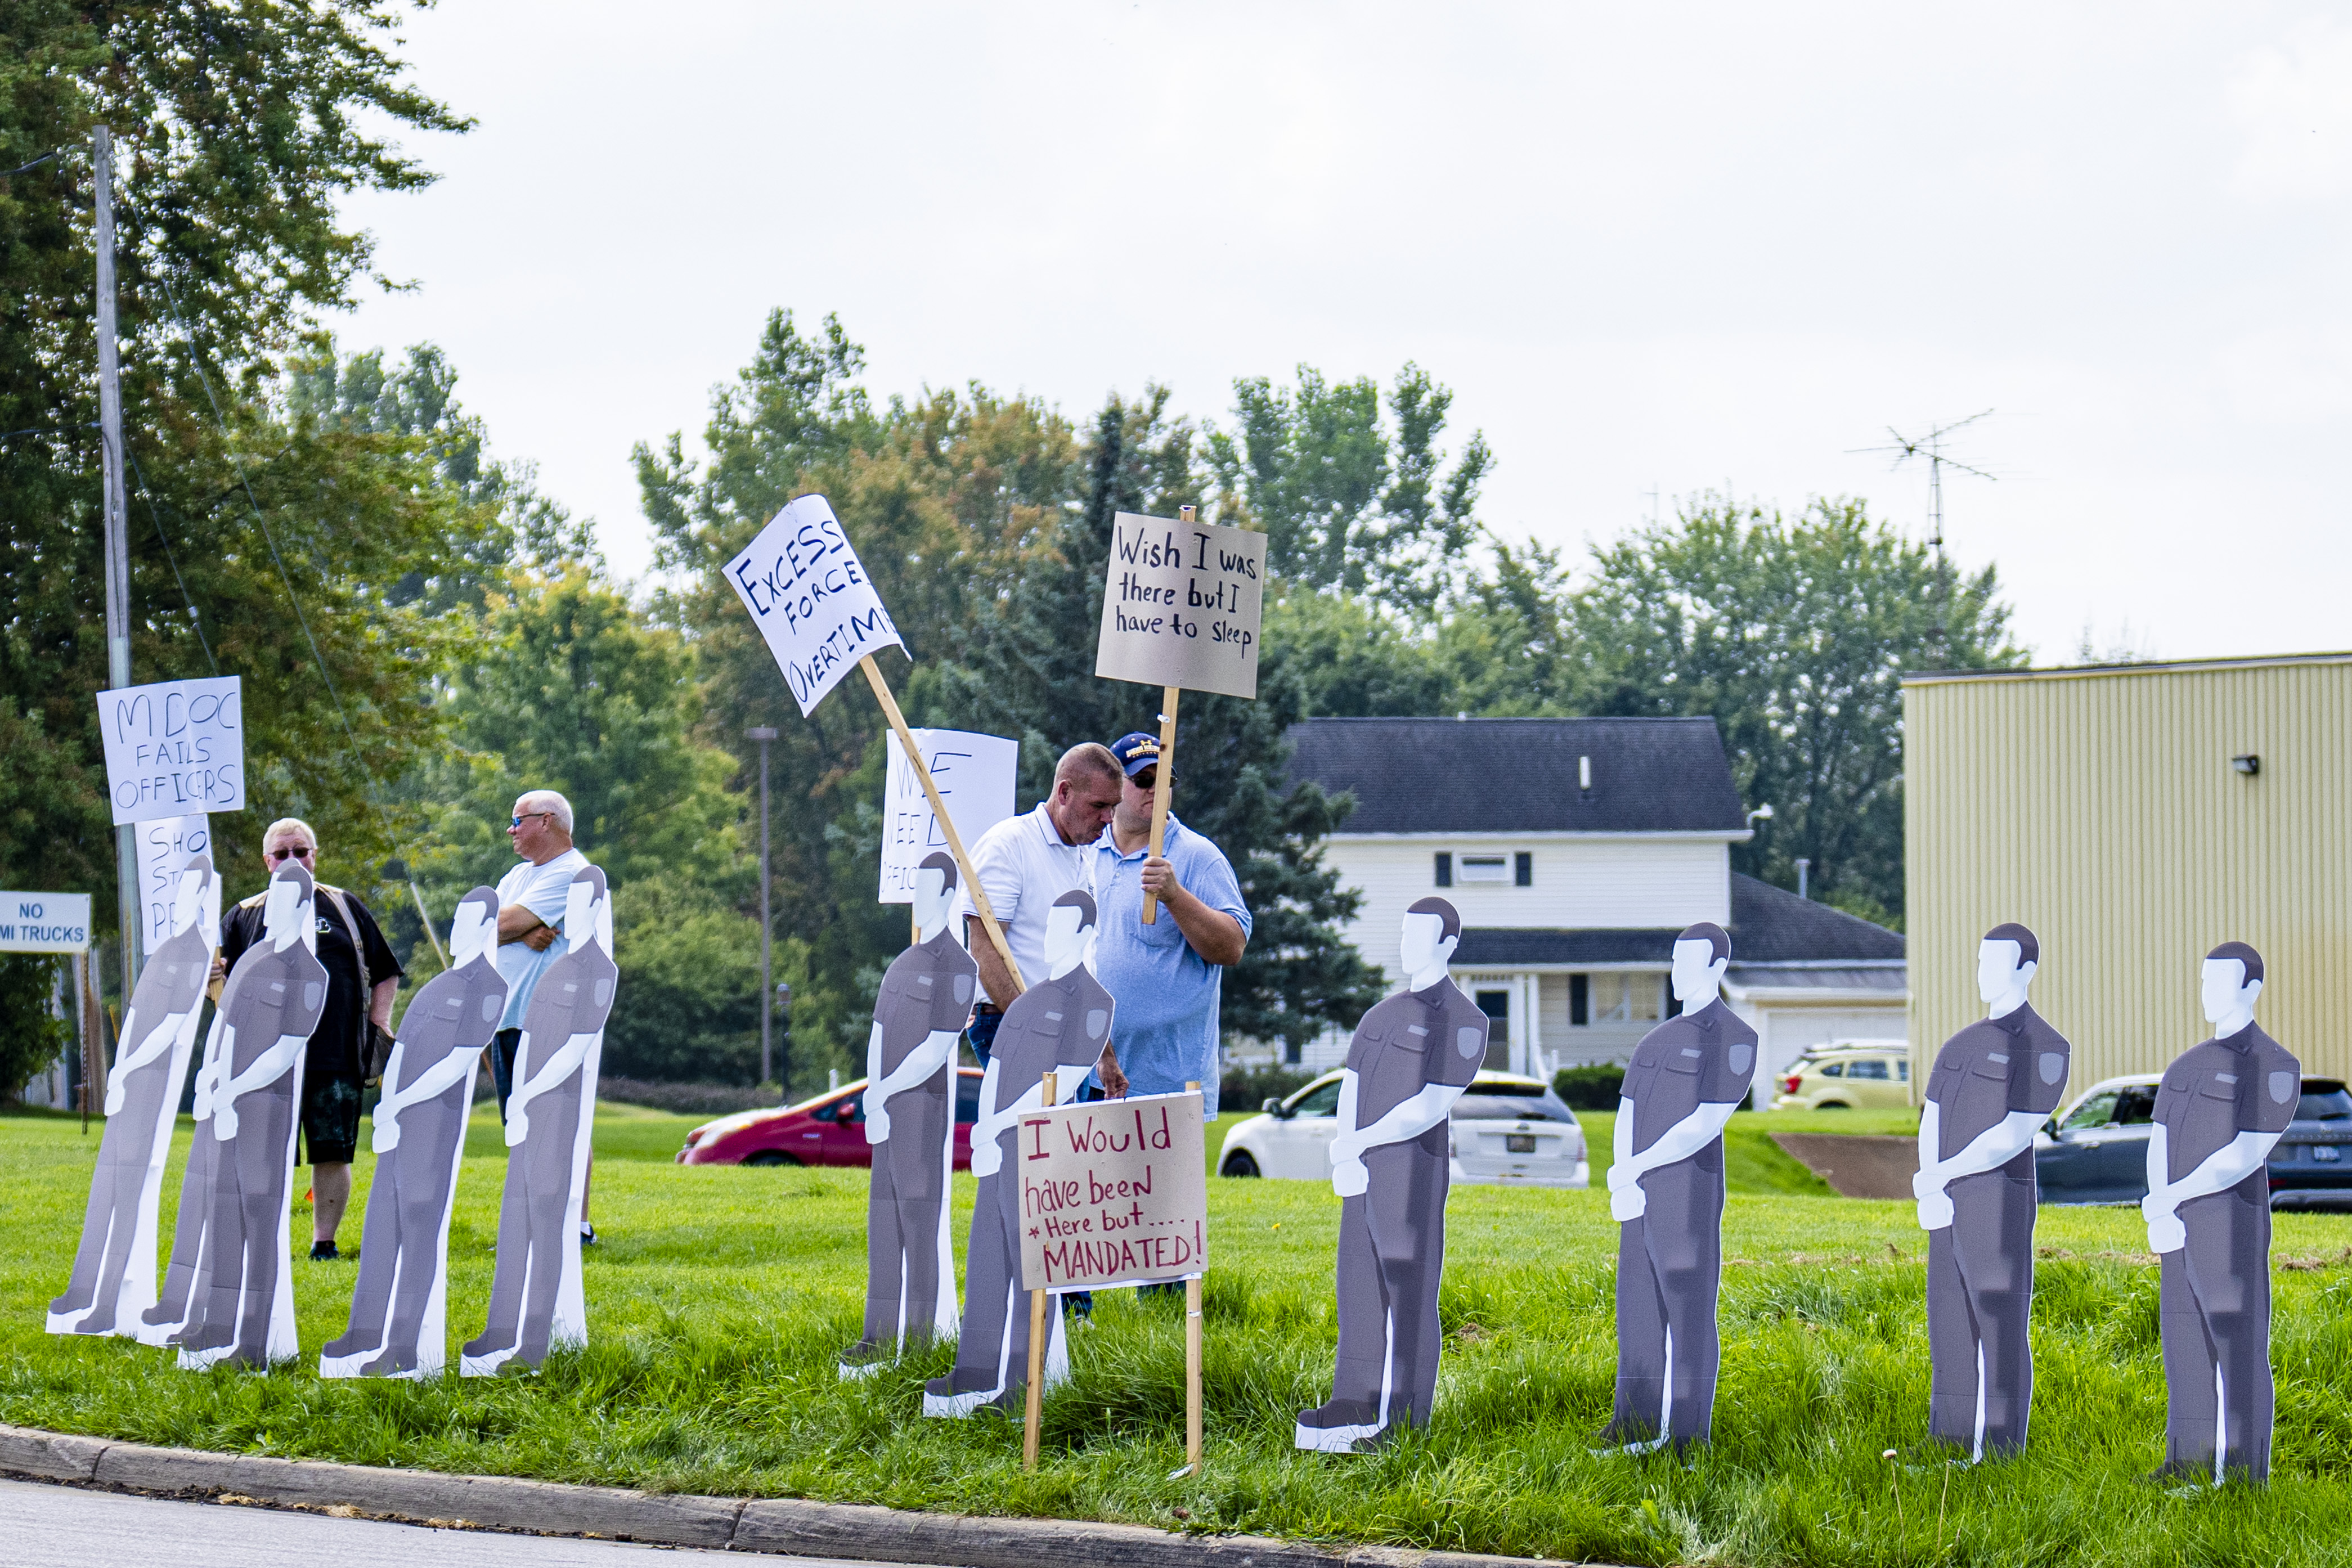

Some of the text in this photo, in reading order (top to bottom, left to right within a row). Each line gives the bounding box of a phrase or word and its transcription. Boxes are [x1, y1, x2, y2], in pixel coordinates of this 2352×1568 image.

[736, 520, 845, 617] EXCESS
[1119, 525, 1256, 579] Wish I was
[784, 560, 862, 636] FORCE
[1119, 572, 1240, 613] there but I
[1116, 605, 1163, 634] have
[1169, 613, 1198, 638] to
[117, 692, 236, 744] MDOC
[137, 737, 212, 767] FAILS
[116, 764, 235, 808] OFFICERS
[881, 861, 918, 893] OFFIC
[19, 902, 43, 919] NO
[19, 925, 84, 942] TRUCKS
[1024, 1106, 1171, 1161] I Would
[1026, 1176, 1081, 1217] have
[1043, 1220, 1202, 1283] MANDATED!
